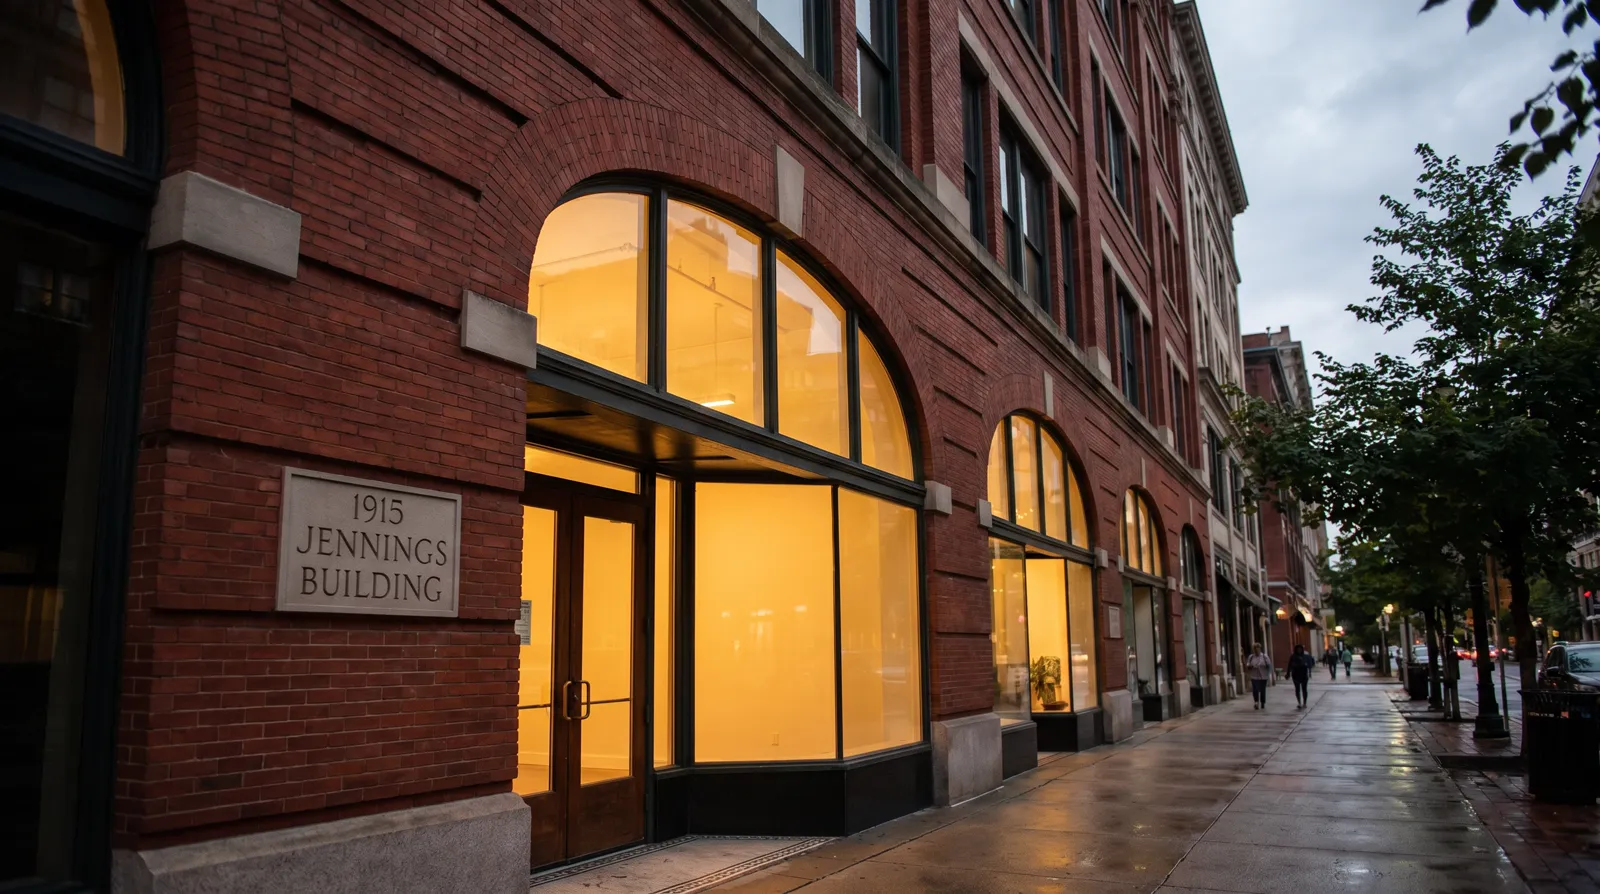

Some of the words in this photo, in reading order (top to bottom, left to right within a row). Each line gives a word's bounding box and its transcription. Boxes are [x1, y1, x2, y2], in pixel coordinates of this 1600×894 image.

[353, 493, 404, 525] 1915
[296, 525, 448, 566] JENNINGS
[300, 566, 442, 602] BUILDING
